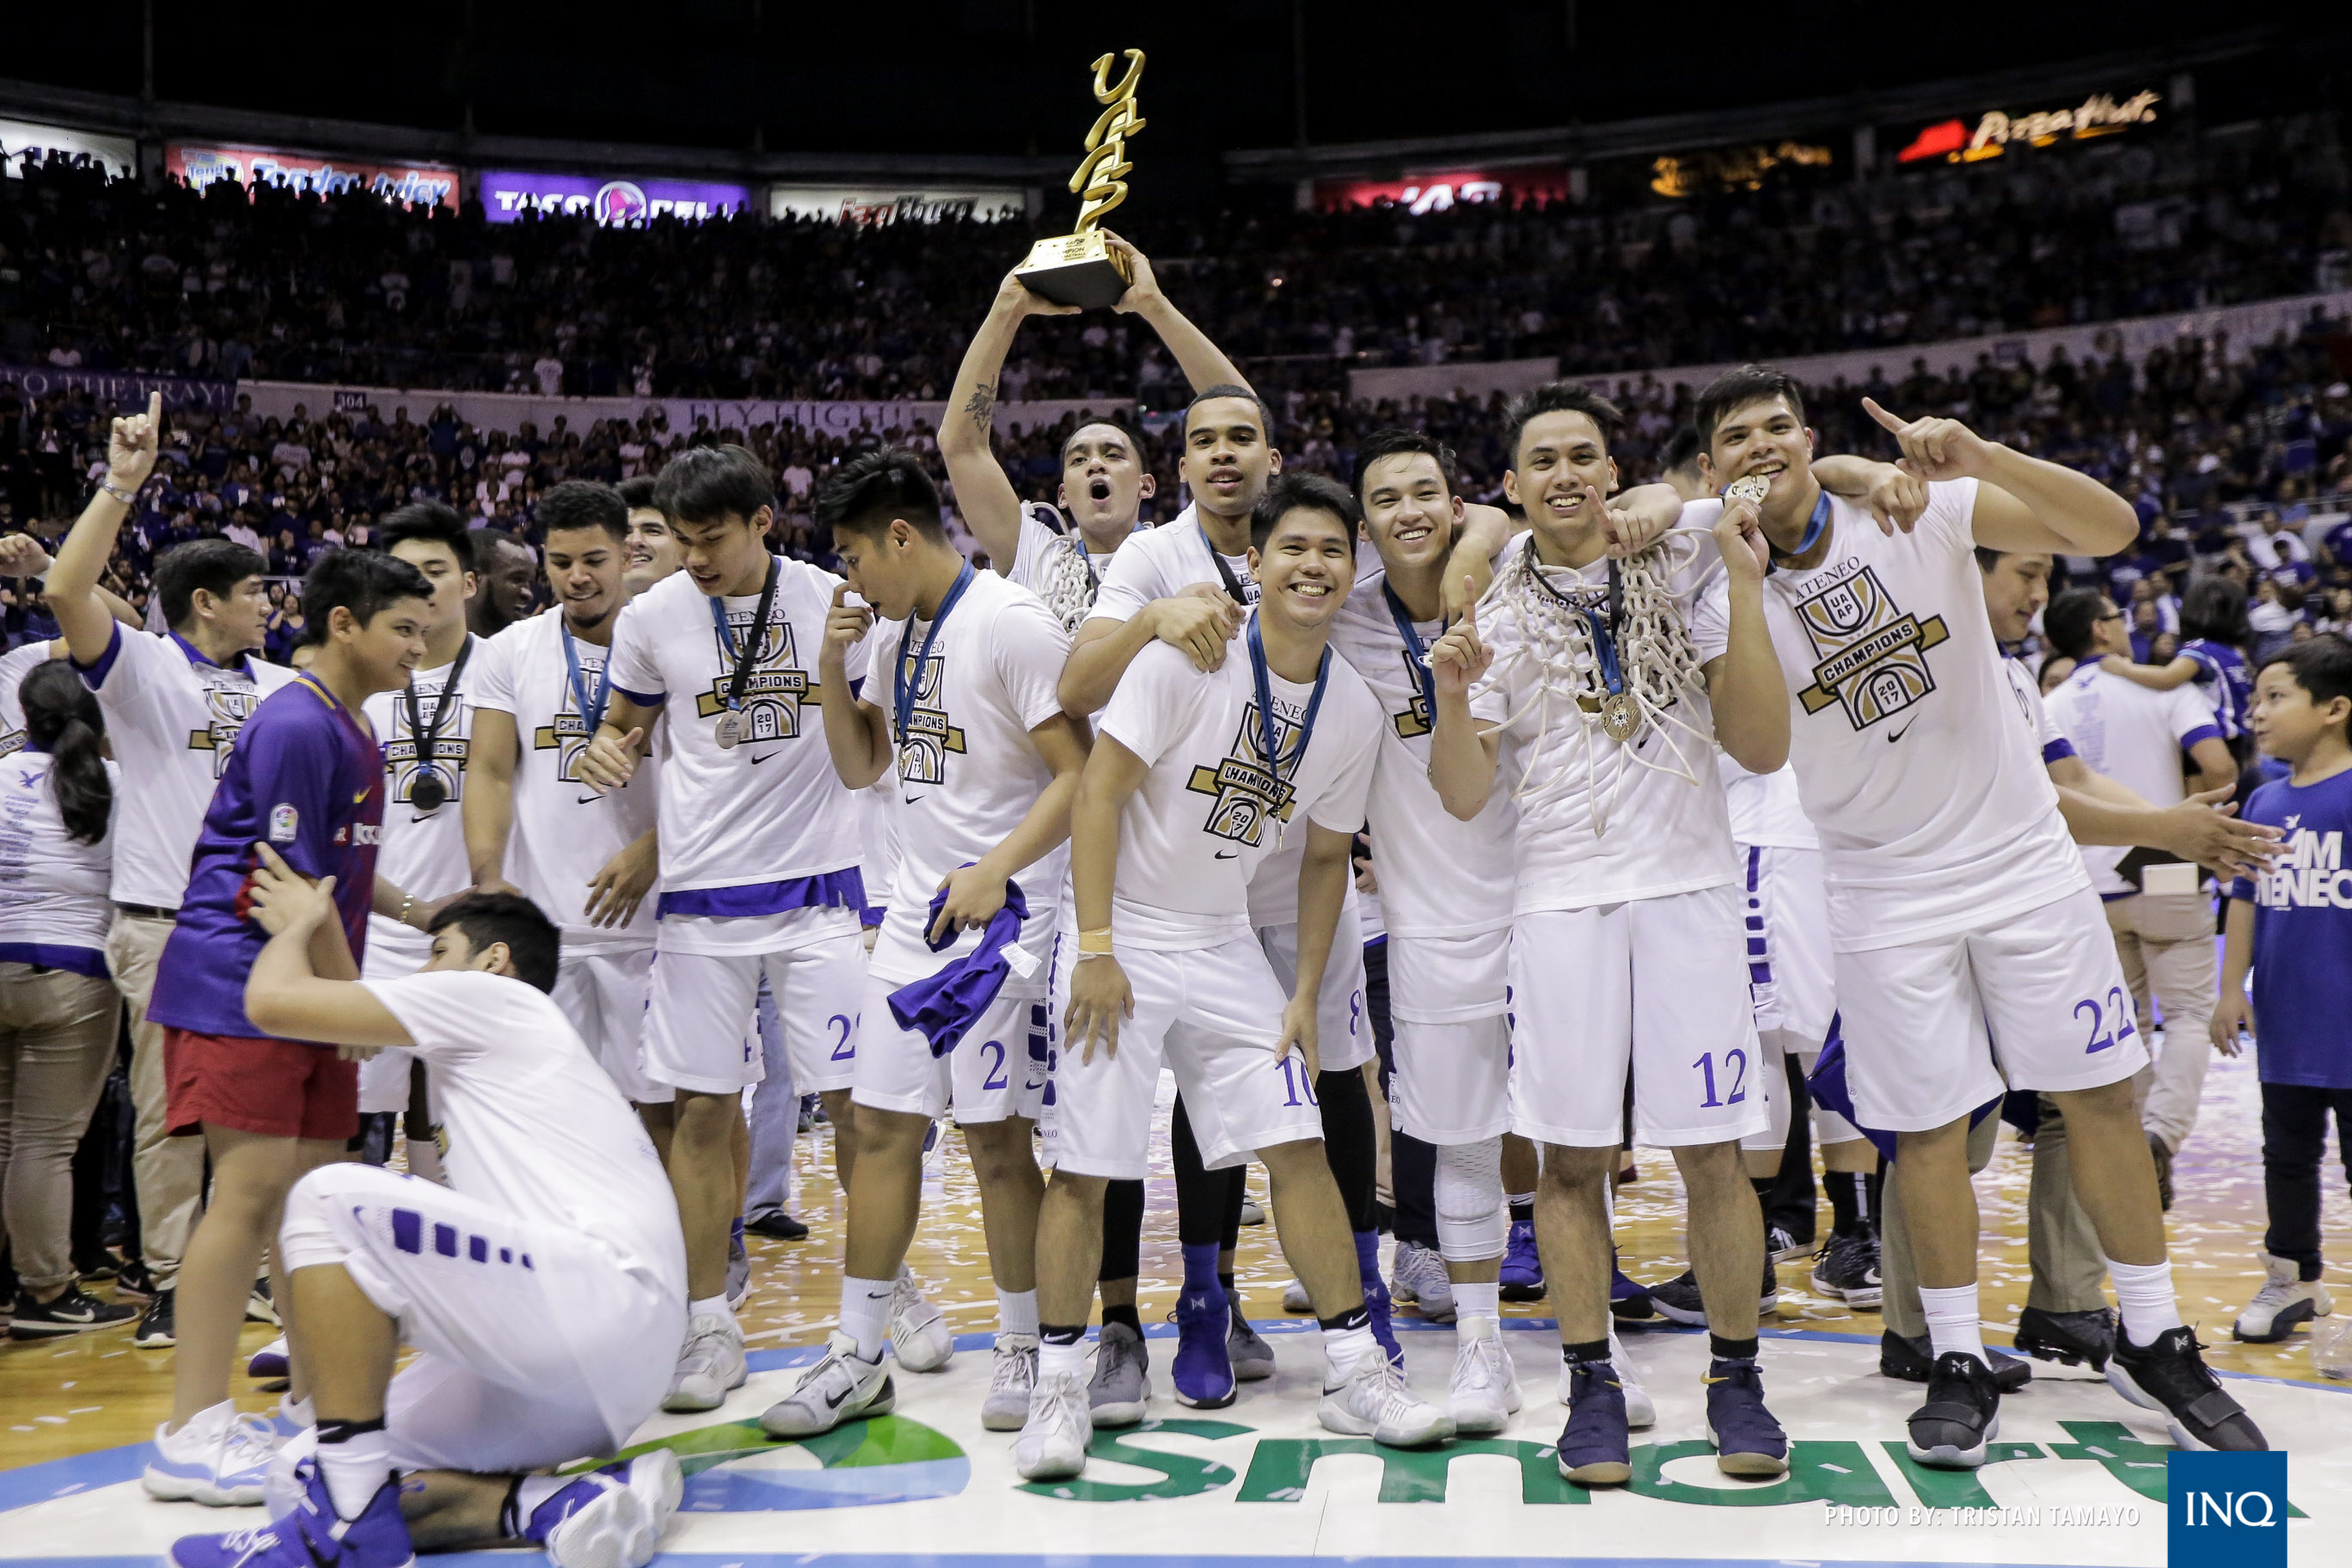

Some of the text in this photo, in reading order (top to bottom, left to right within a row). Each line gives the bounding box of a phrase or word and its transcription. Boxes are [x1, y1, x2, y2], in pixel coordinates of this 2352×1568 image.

[1796, 556, 1860, 602] ATENEO
[1830, 593, 1849, 608] UA
[1837, 603, 1853, 619] AP
[1823, 623, 1914, 682] CHAMPIONS
[721, 676, 802, 693] CMPIONS
[1877, 680, 1896, 696] 20
[1883, 690, 1900, 705] 17
[756, 714, 772, 724] 20
[910, 714, 944, 730] MPIONS
[758, 724, 772, 733] 17
[391, 744, 464, 757] CHAIONS
[1233, 812, 1249, 824] 20
[2073, 986, 2135, 1054] 22
[827, 1013, 860, 1062] 2
[980, 1039, 1008, 1090] 2
[1692, 1048, 1746, 1107] 12
